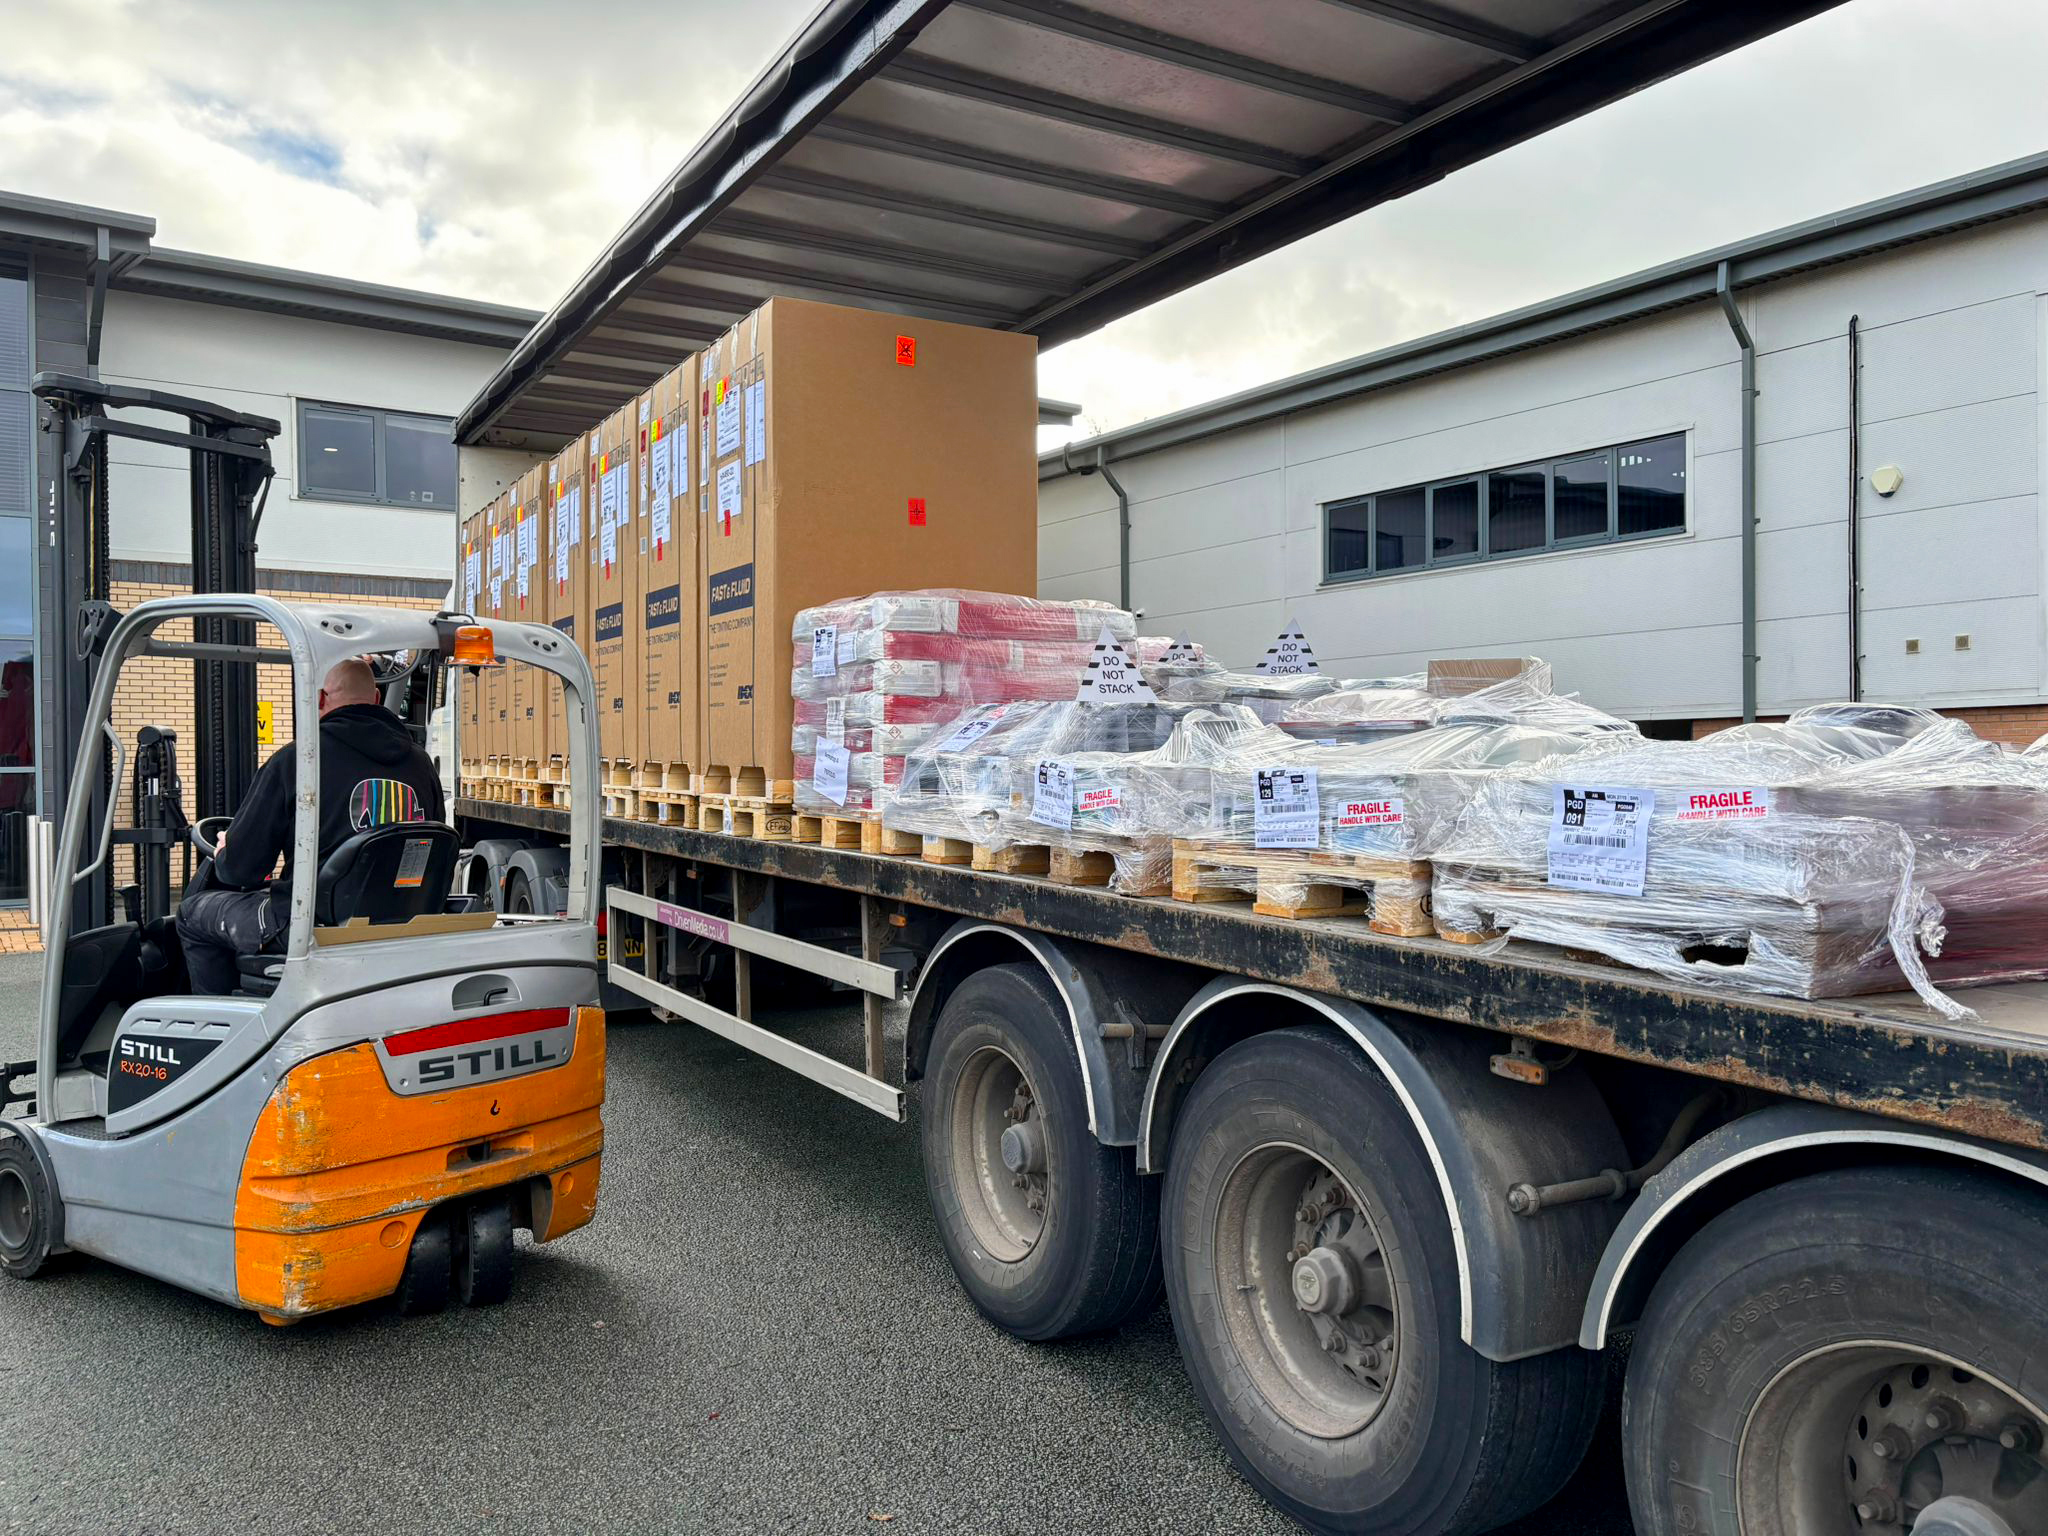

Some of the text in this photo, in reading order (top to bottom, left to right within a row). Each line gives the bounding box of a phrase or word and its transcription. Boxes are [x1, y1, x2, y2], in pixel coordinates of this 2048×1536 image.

[711, 583, 727, 603] FAST
[730, 577, 751, 598] FLUID
[648, 600, 660, 618] FAST
[662, 597, 678, 615] FLUID
[1282, 643, 1297, 651] DO
[1103, 656, 1120, 666] DO
[1277, 654, 1299, 663] NOT
[1102, 670, 1125, 680] NOT
[1270, 665, 1303, 674] STACK
[1099, 684, 1135, 694] STACK
[1084, 789, 1113, 802] FRAGILE
[1261, 789, 1272, 798] 129
[1567, 800, 1584, 809] PGD
[1690, 791, 1753, 809] FRAGILE
[1347, 802, 1392, 815] FRAGILE
[1677, 806, 1766, 820] HANDLE WITH CARE
[1340, 813, 1402, 825] HANDLE WITH CARE
[1566, 813, 1582, 825] 091
[121, 1039, 181, 1065] STILL
[419, 1040, 557, 1084] STILL
[121, 1060, 168, 1080] RX20-16
